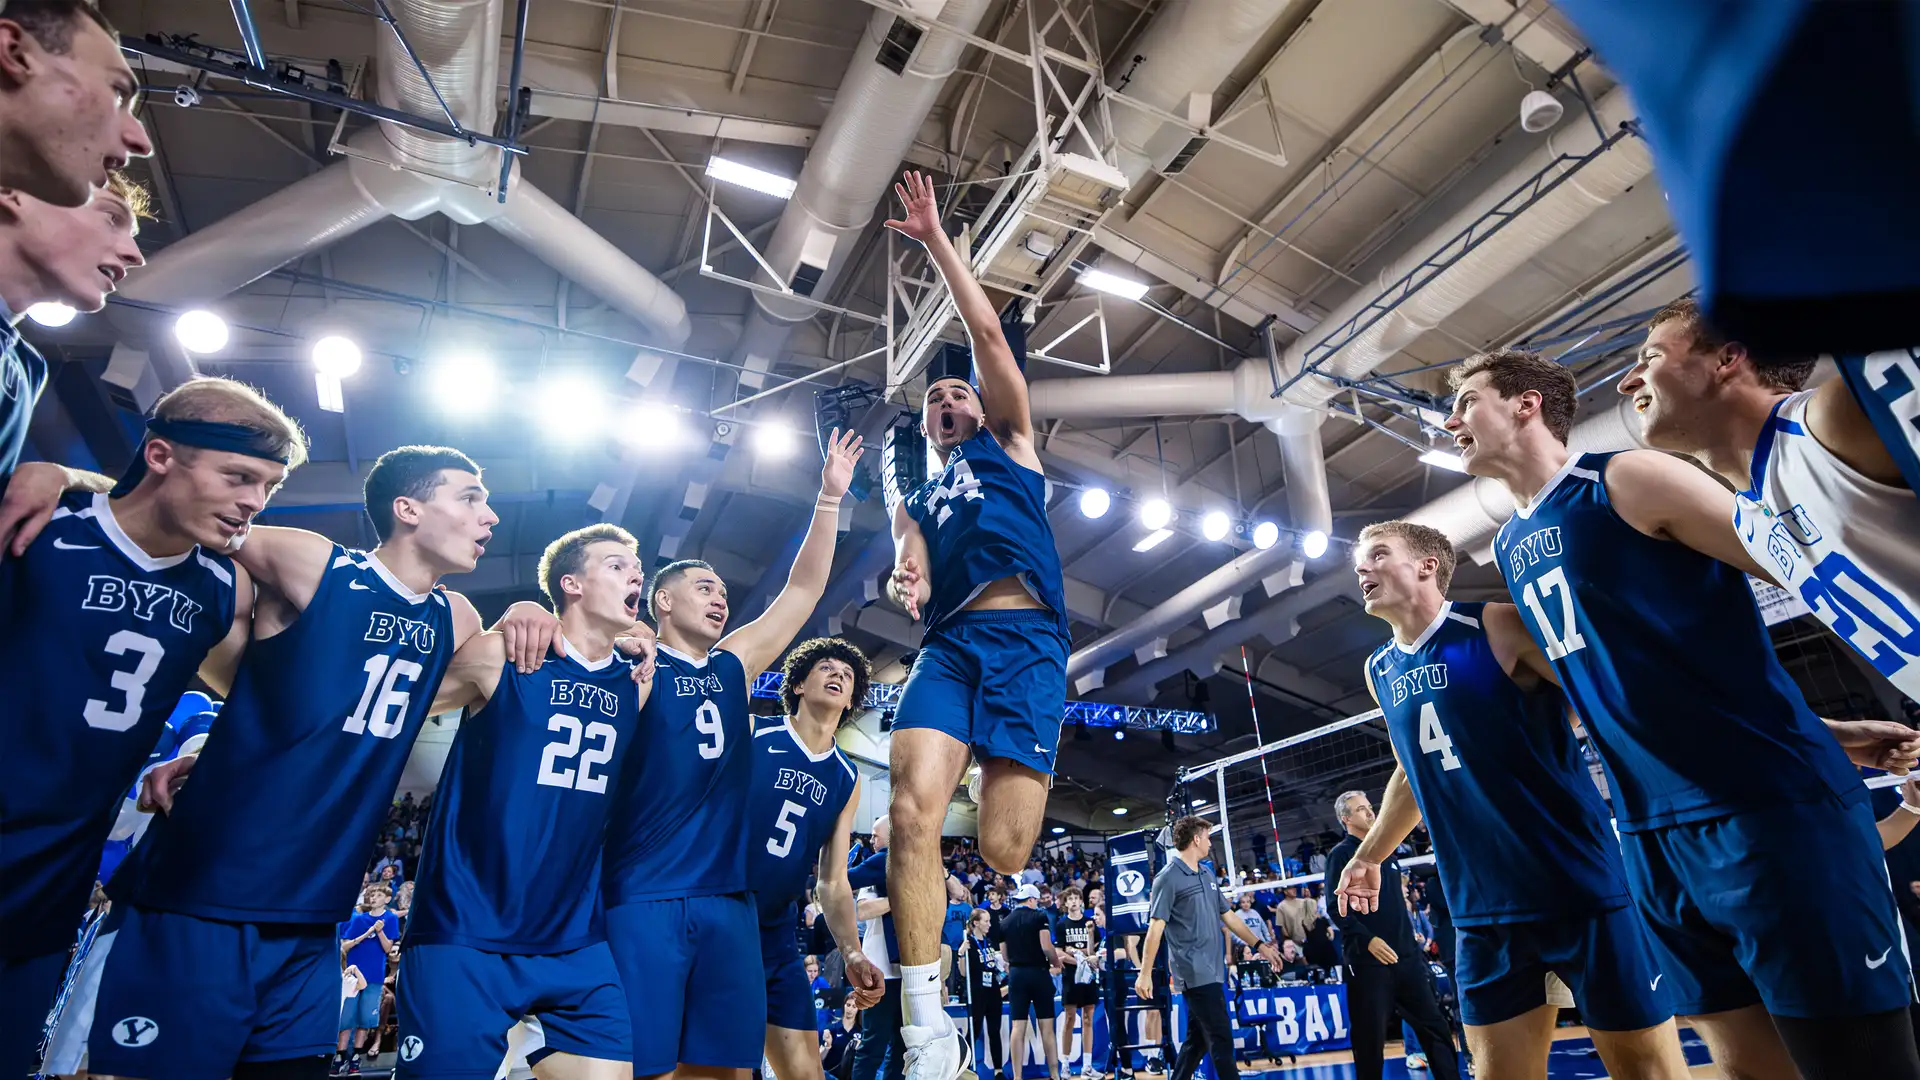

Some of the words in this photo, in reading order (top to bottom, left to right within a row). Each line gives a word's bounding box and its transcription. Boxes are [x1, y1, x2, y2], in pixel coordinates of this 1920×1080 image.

[1509, 526, 1564, 582] BYU
[1768, 503, 1823, 581] BYU
[82, 574, 203, 634] BYU
[364, 611, 436, 654] BYU
[1522, 565, 1586, 661] 17
[1799, 550, 1920, 678] 20
[82, 630, 165, 732] 3
[342, 654, 423, 740] 16
[550, 679, 619, 718] BYU
[674, 673, 723, 697] BYU
[1392, 662, 1449, 708] BYU
[536, 713, 618, 794] 22
[694, 699, 725, 759] 9
[1418, 701, 1462, 771] 4
[773, 767, 828, 806] BYU
[765, 799, 807, 859] 5
[1119, 872, 1140, 893] Y
[121, 1017, 156, 1045] Y
[403, 1036, 421, 1060] Y
